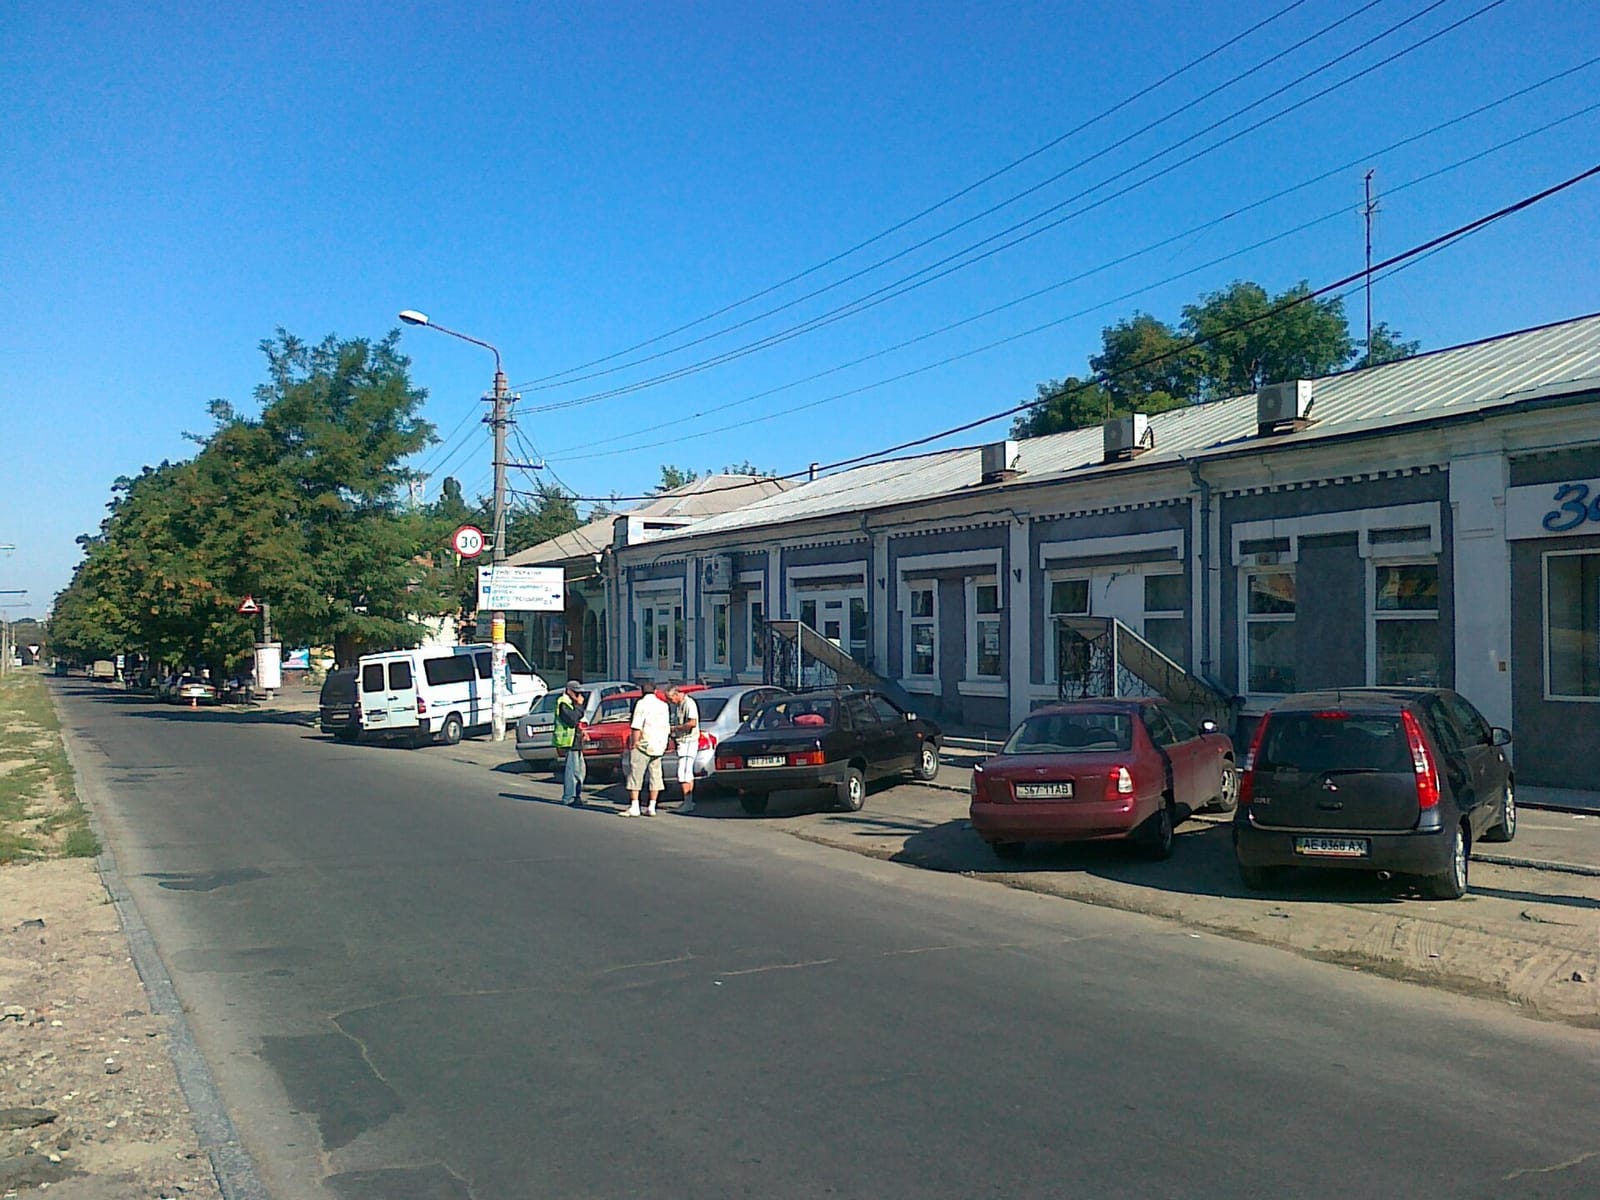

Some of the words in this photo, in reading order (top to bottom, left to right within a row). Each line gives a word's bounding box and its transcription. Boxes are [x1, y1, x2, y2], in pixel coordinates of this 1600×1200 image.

[460, 536, 479, 549] 30
[1304, 839, 1319, 850] AE
[1348, 840, 1363, 852] AX
